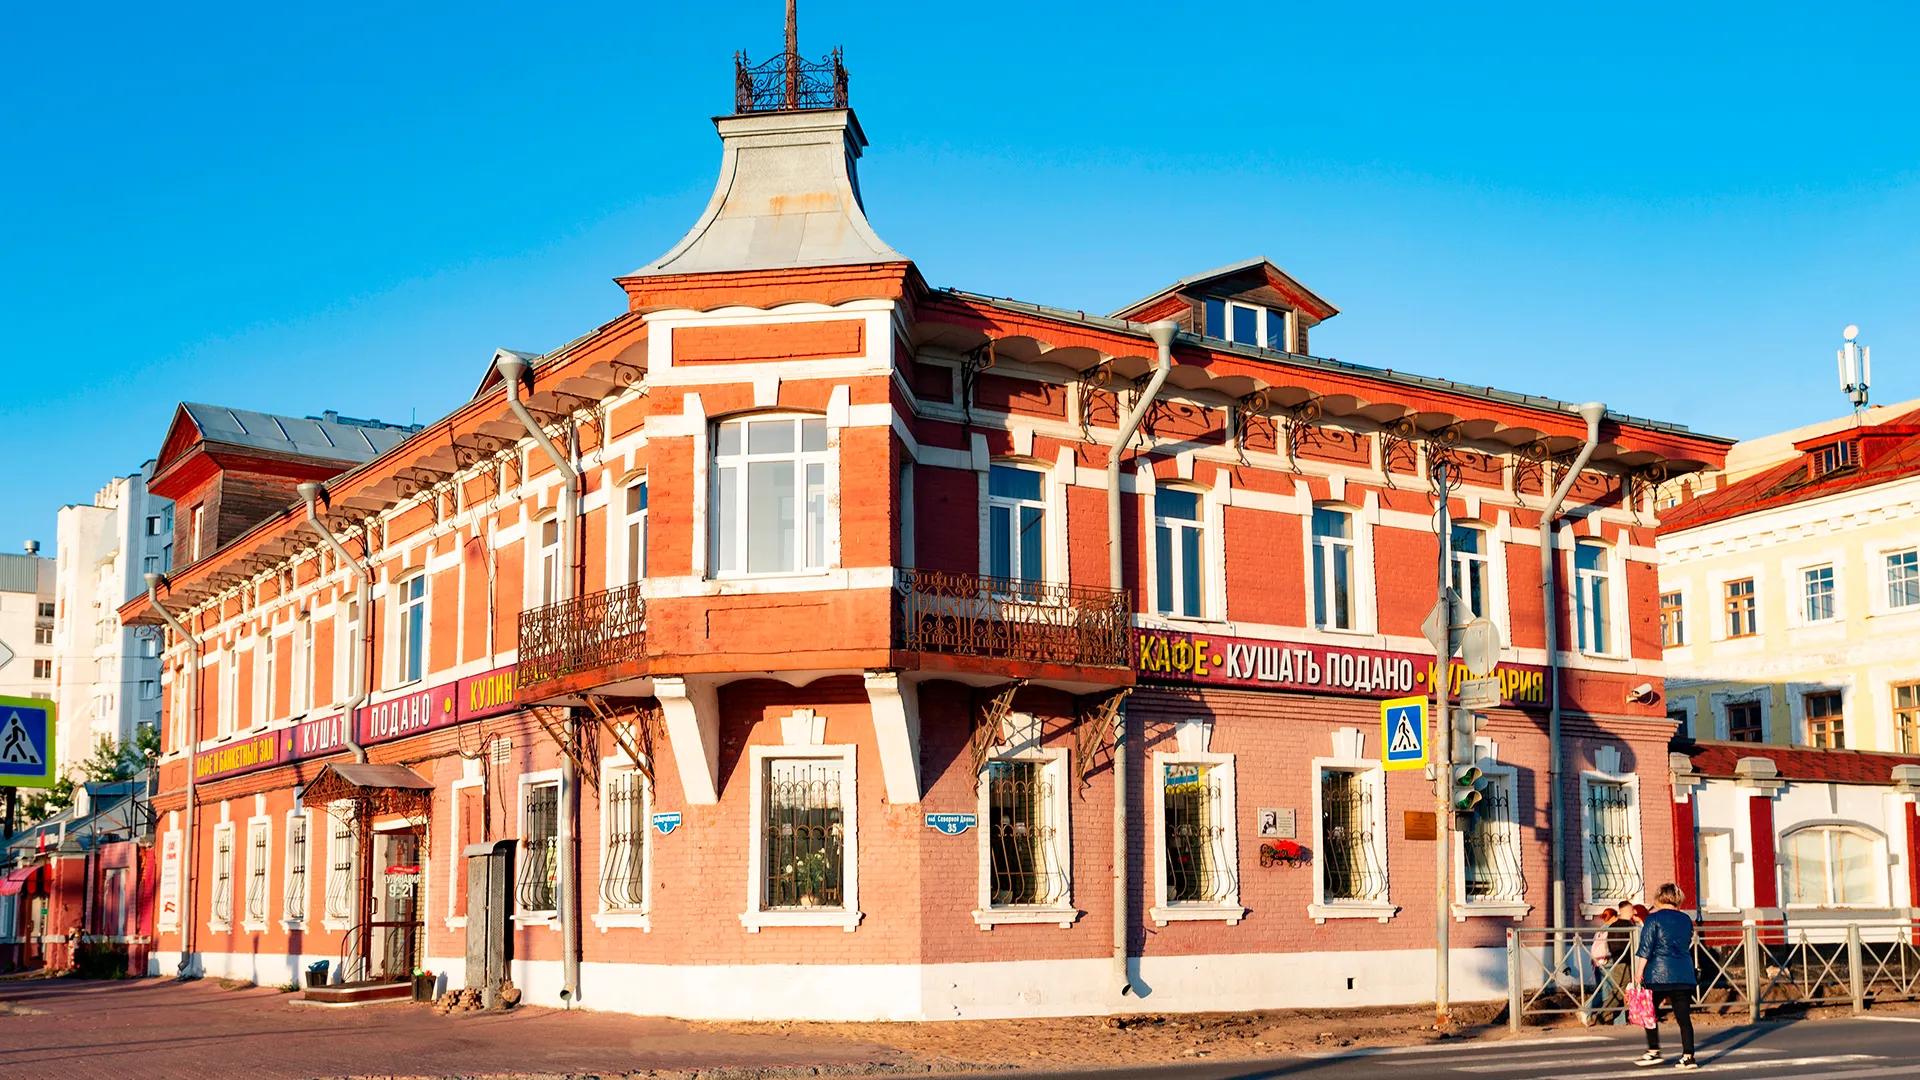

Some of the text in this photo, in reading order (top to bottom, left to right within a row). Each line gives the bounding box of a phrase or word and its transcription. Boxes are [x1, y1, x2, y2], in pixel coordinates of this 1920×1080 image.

[1140, 635, 1543, 703] КАФЕ КУШАТЬ ПОДАНО КУЛАРИЯ
[197, 755, 212, 777] КАФЕ
[220, 737, 258, 771] БАНКЕТНЫЙ
[260, 737, 274, 762] ЗАЛ
[303, 715, 345, 753] КУШАТ
[370, 693, 430, 738] ПОДАНО
[948, 823, 957, 833] 35
